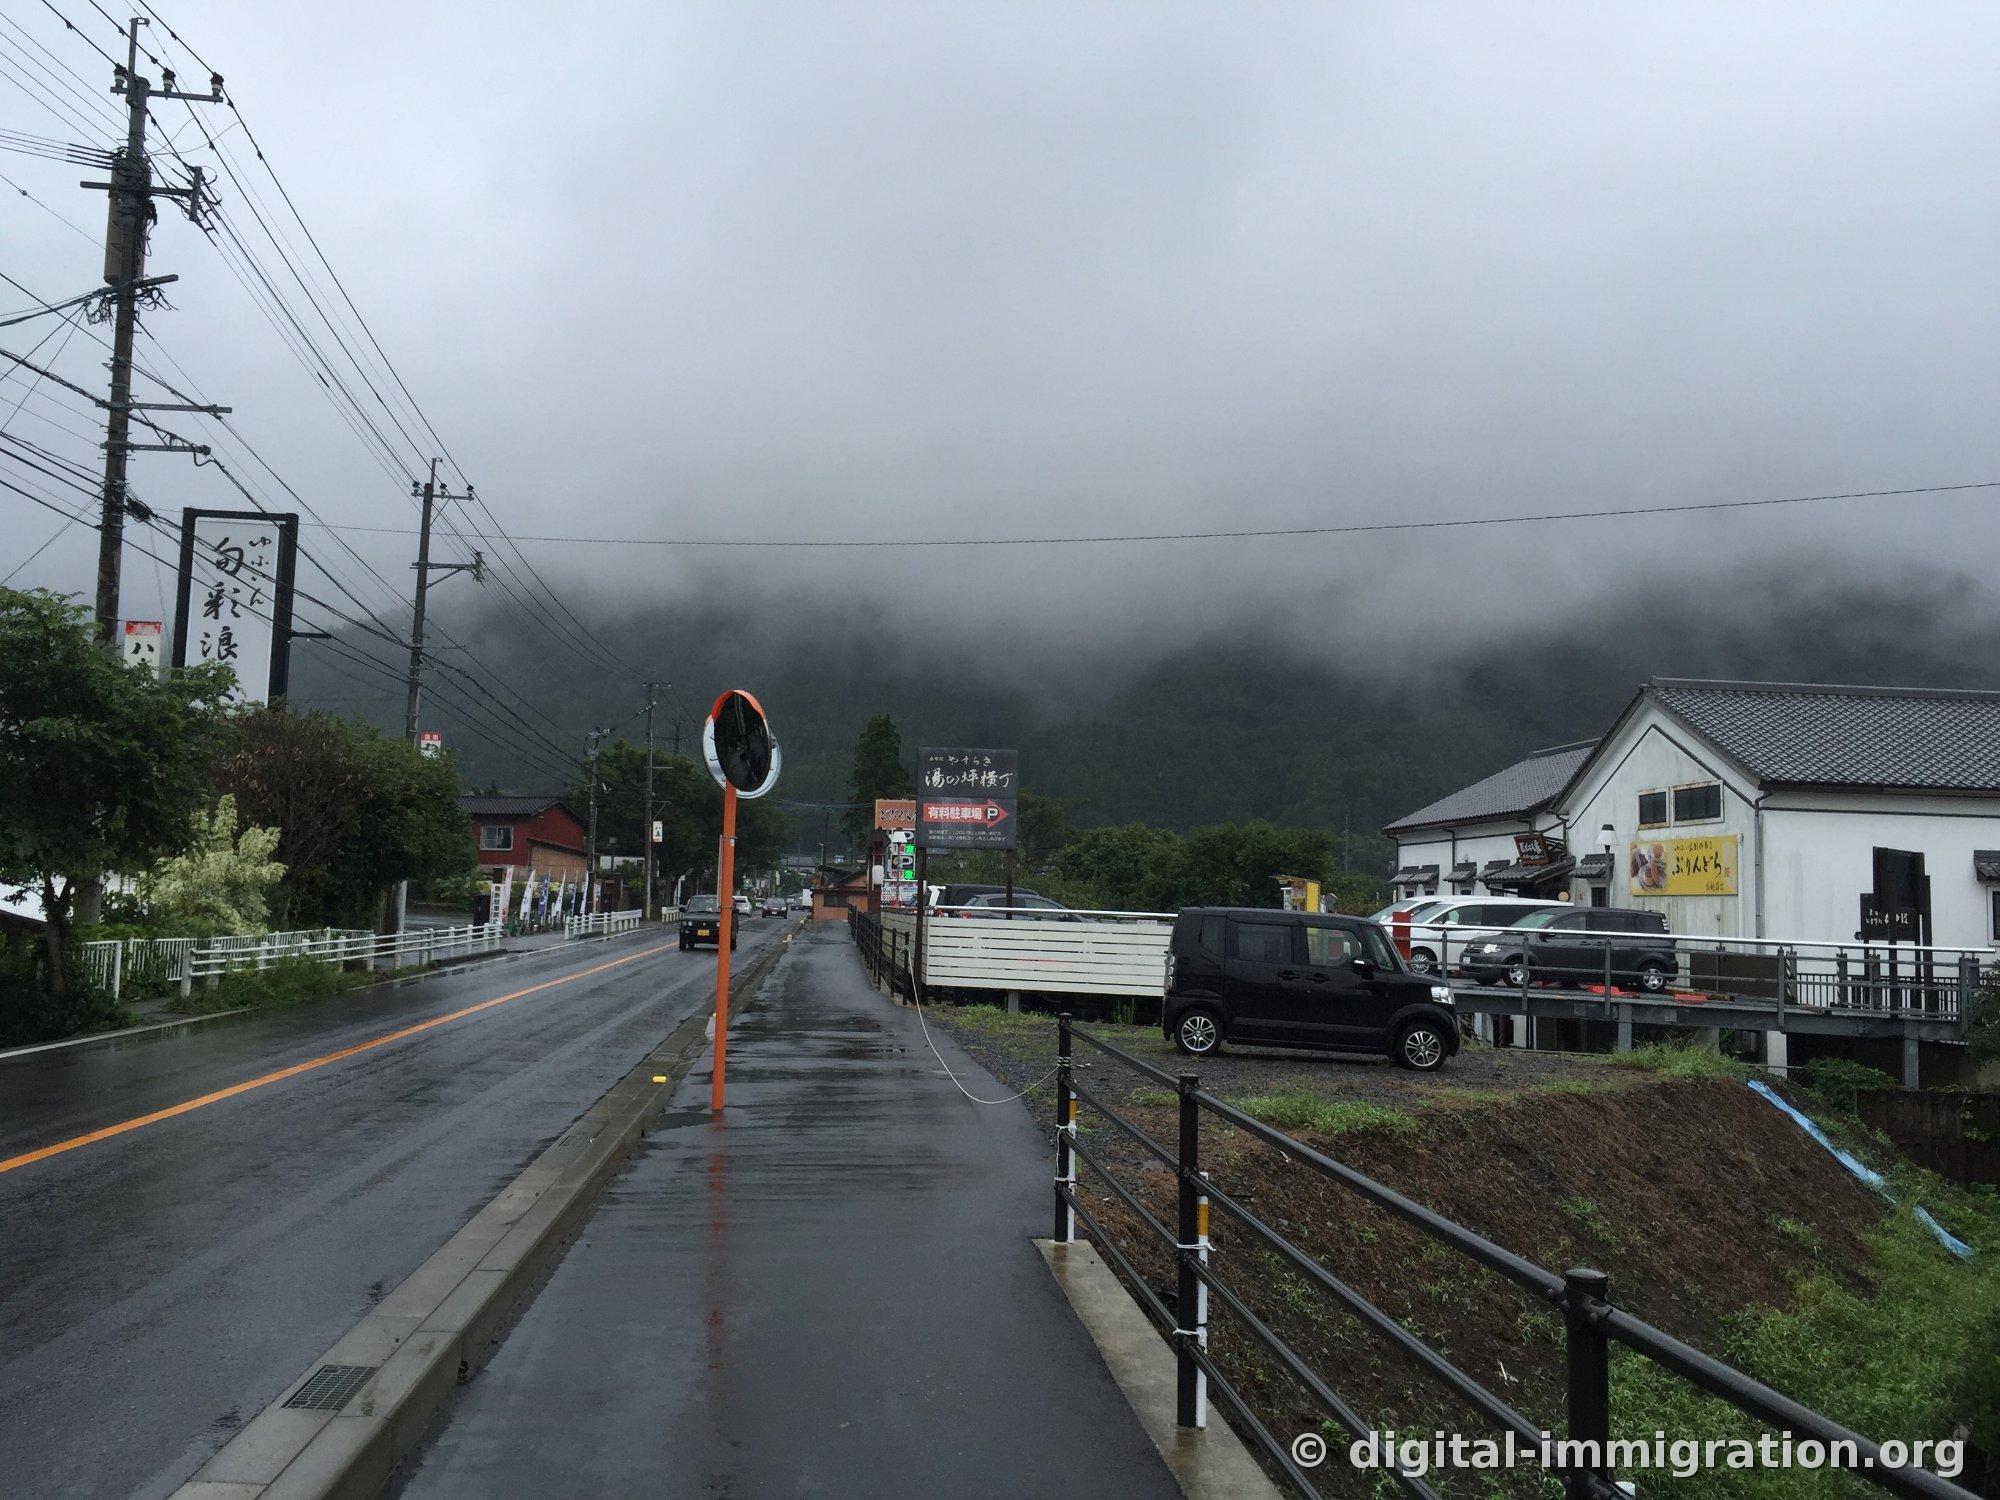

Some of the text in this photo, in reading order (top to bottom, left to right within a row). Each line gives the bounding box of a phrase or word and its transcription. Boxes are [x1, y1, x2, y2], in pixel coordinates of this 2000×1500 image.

[200, 536, 244, 702] 旬彩浪
[925, 767, 1013, 788] 湯の坪横丁
[928, 806, 982, 819] 有料駐車場
[987, 807, 998, 820] P
